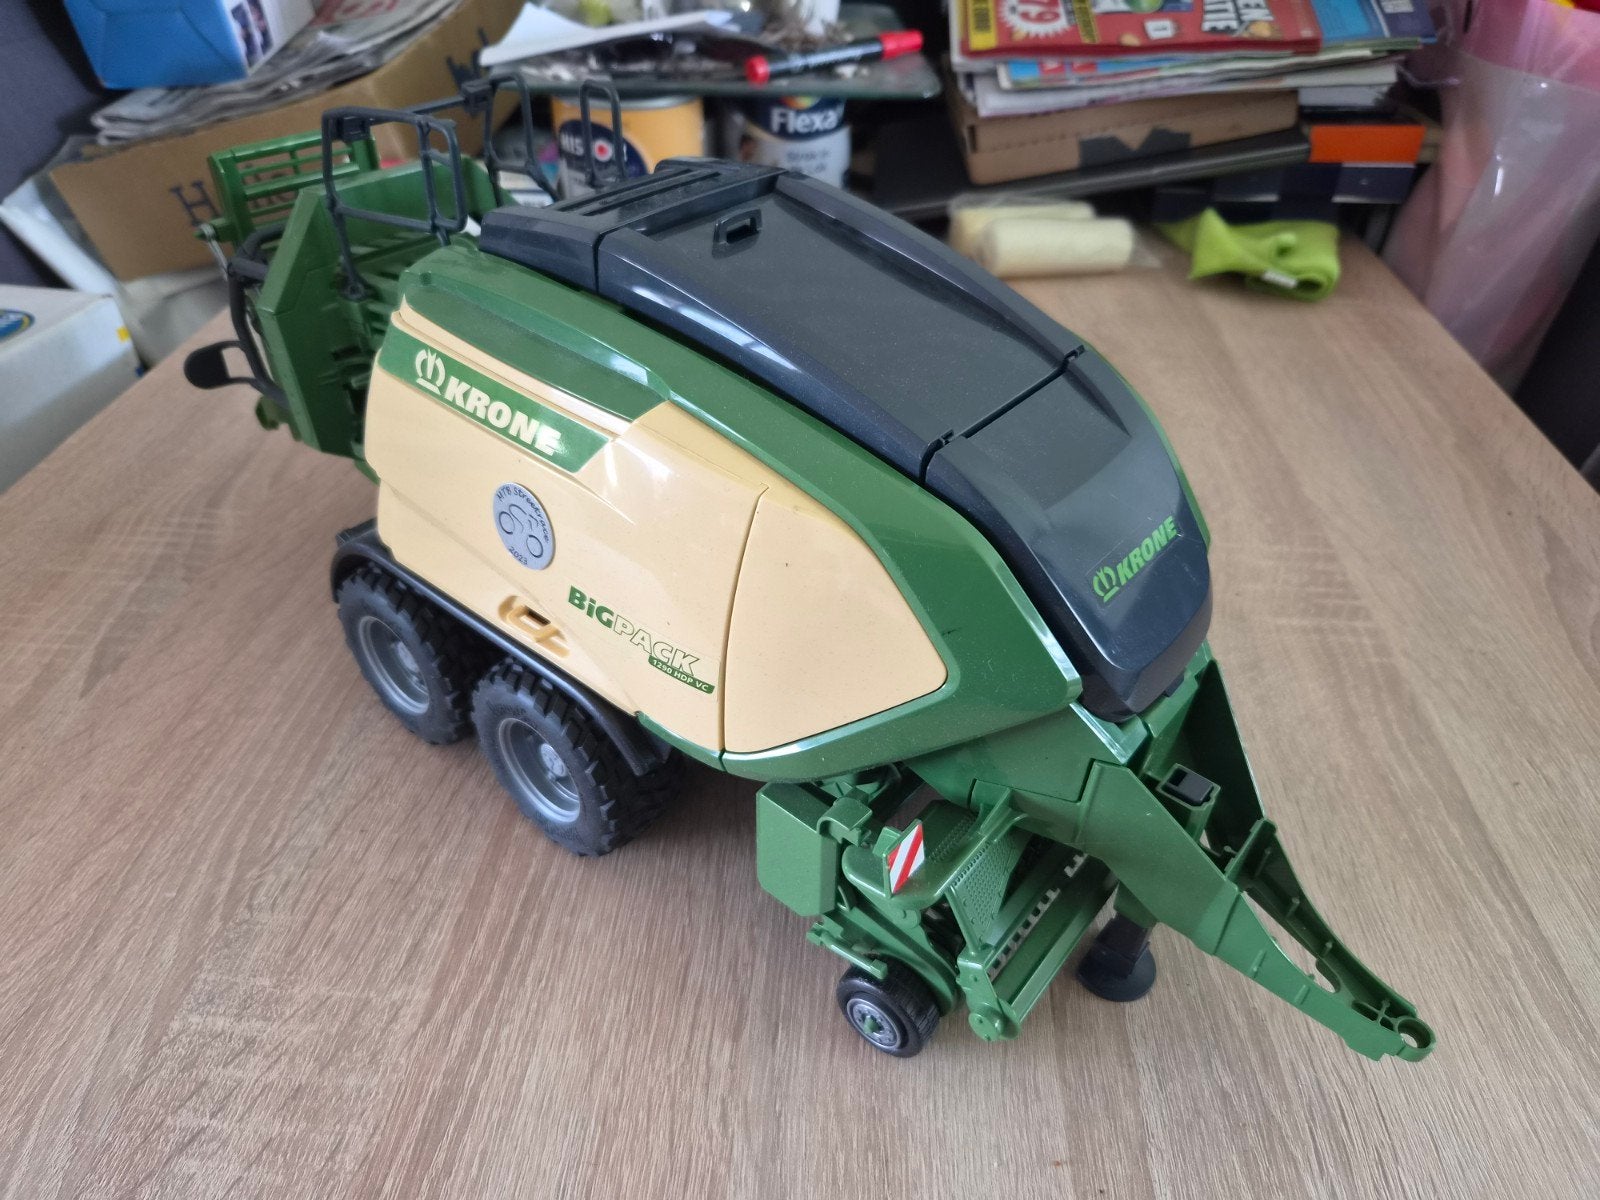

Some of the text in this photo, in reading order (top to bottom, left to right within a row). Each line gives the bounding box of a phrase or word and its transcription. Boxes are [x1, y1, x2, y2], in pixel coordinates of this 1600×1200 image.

[771, 107, 838, 134] Flexa
[444, 375, 562, 456] KRONE
[508, 546, 528, 565] 2023
[1116, 515, 1178, 586] KRONE
[652, 659, 709, 692] 1290 HDP VC
